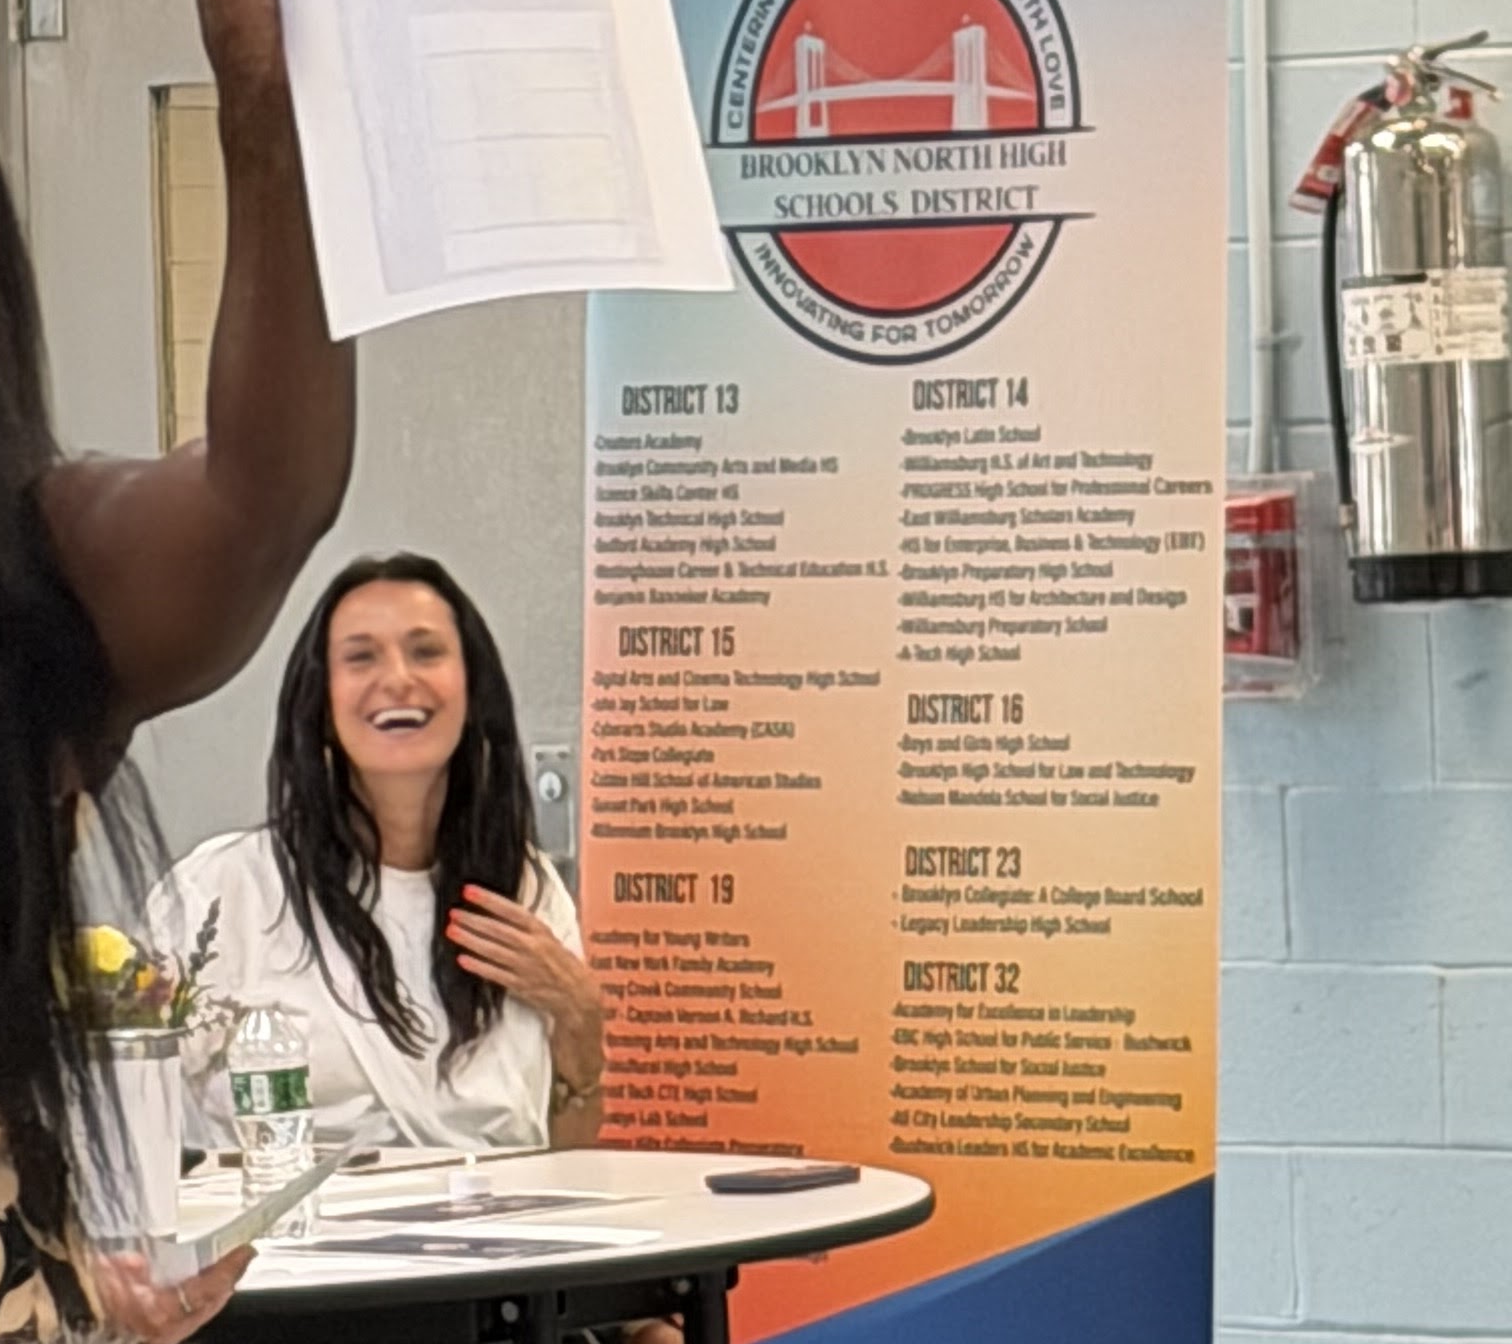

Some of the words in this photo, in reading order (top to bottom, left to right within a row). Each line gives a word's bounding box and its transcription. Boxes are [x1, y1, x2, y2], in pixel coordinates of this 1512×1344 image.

[1039, 34, 1065, 110] LOVE
[741, 148, 886, 179] BROOKLYN
[894, 144, 993, 174] NORTH
[999, 140, 1066, 168] HIGH
[774, 191, 899, 218] SCHOOLS
[912, 185, 1039, 214] DISTRICT
[754, 242, 864, 342] INNOVATING
[872, 324, 917, 344] FOR
[925, 232, 1035, 338] TOMORROW
[622, 384, 708, 416] DISTRICT
[715, 384, 739, 414] 13
[912, 378, 998, 410] DISTRICT
[1006, 377, 1028, 407] 14
[619, 626, 704, 657] DISTRICT
[712, 626, 735, 656] 15
[907, 694, 993, 725] DISTRICT
[1002, 694, 1023, 724] 16
[905, 845, 991, 877] DISTRICT
[996, 847, 1021, 878] 23
[614, 872, 698, 903] DISTRICT
[711, 874, 734, 903] 19
[904, 961, 990, 992] DISTRICT
[995, 962, 1020, 994] 32
